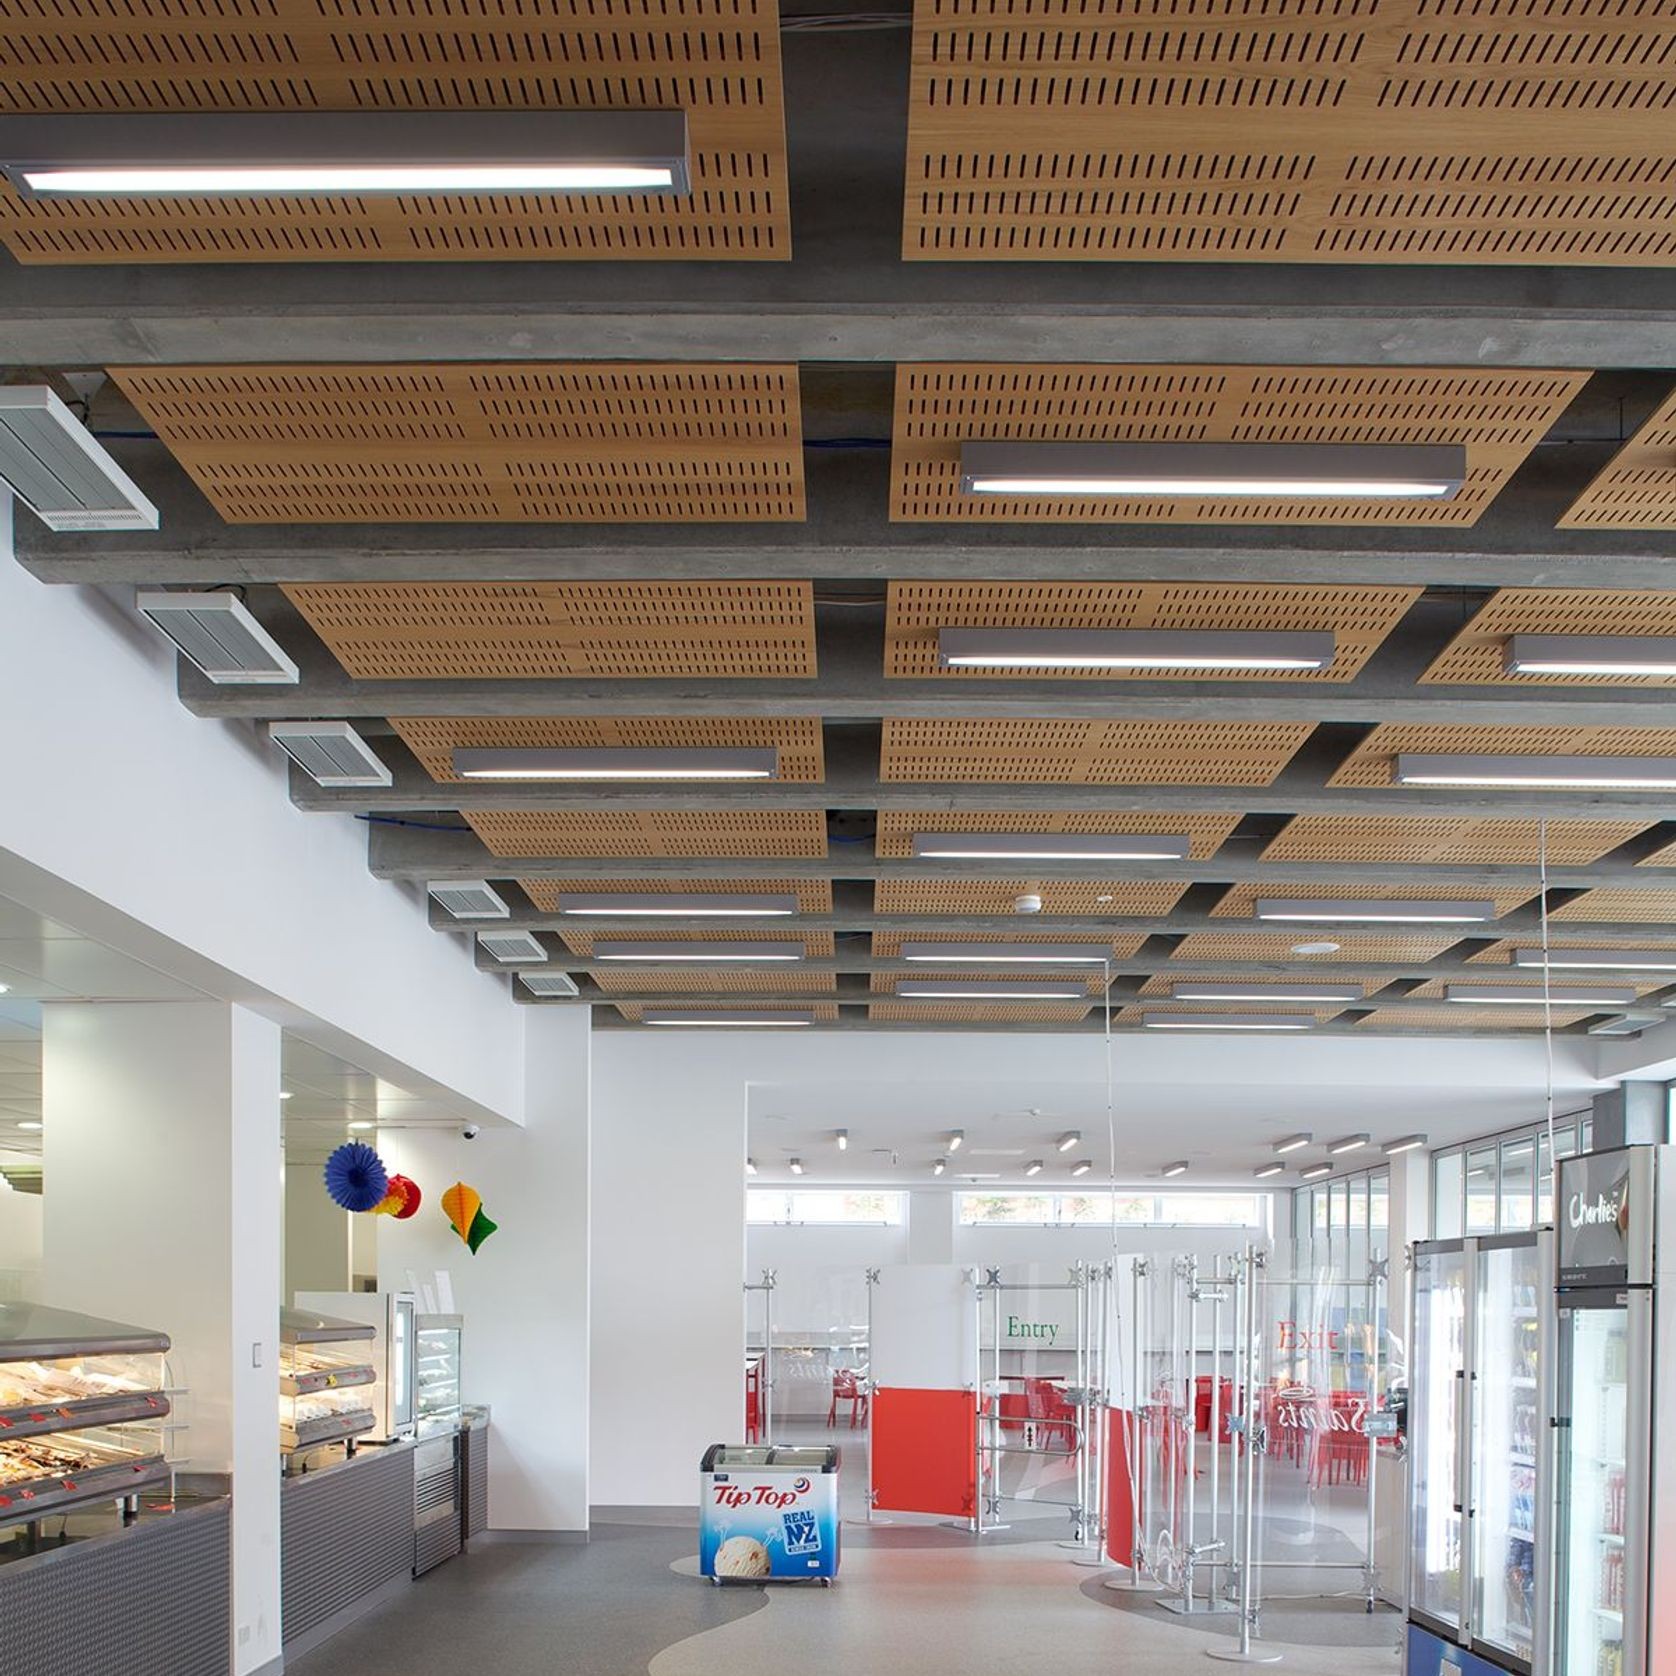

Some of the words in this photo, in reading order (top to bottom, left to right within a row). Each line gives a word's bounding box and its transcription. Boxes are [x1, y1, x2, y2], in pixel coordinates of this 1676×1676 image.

[1569, 1191, 1618, 1228] Charlie's
[1007, 1315, 1059, 1345] Entry
[1277, 1320, 1339, 1350] Exit
[713, 1485, 752, 1508] Tip
[752, 1485, 797, 1508] Top
[783, 1510, 815, 1524] REAL
[785, 1521, 817, 1546] NZ
